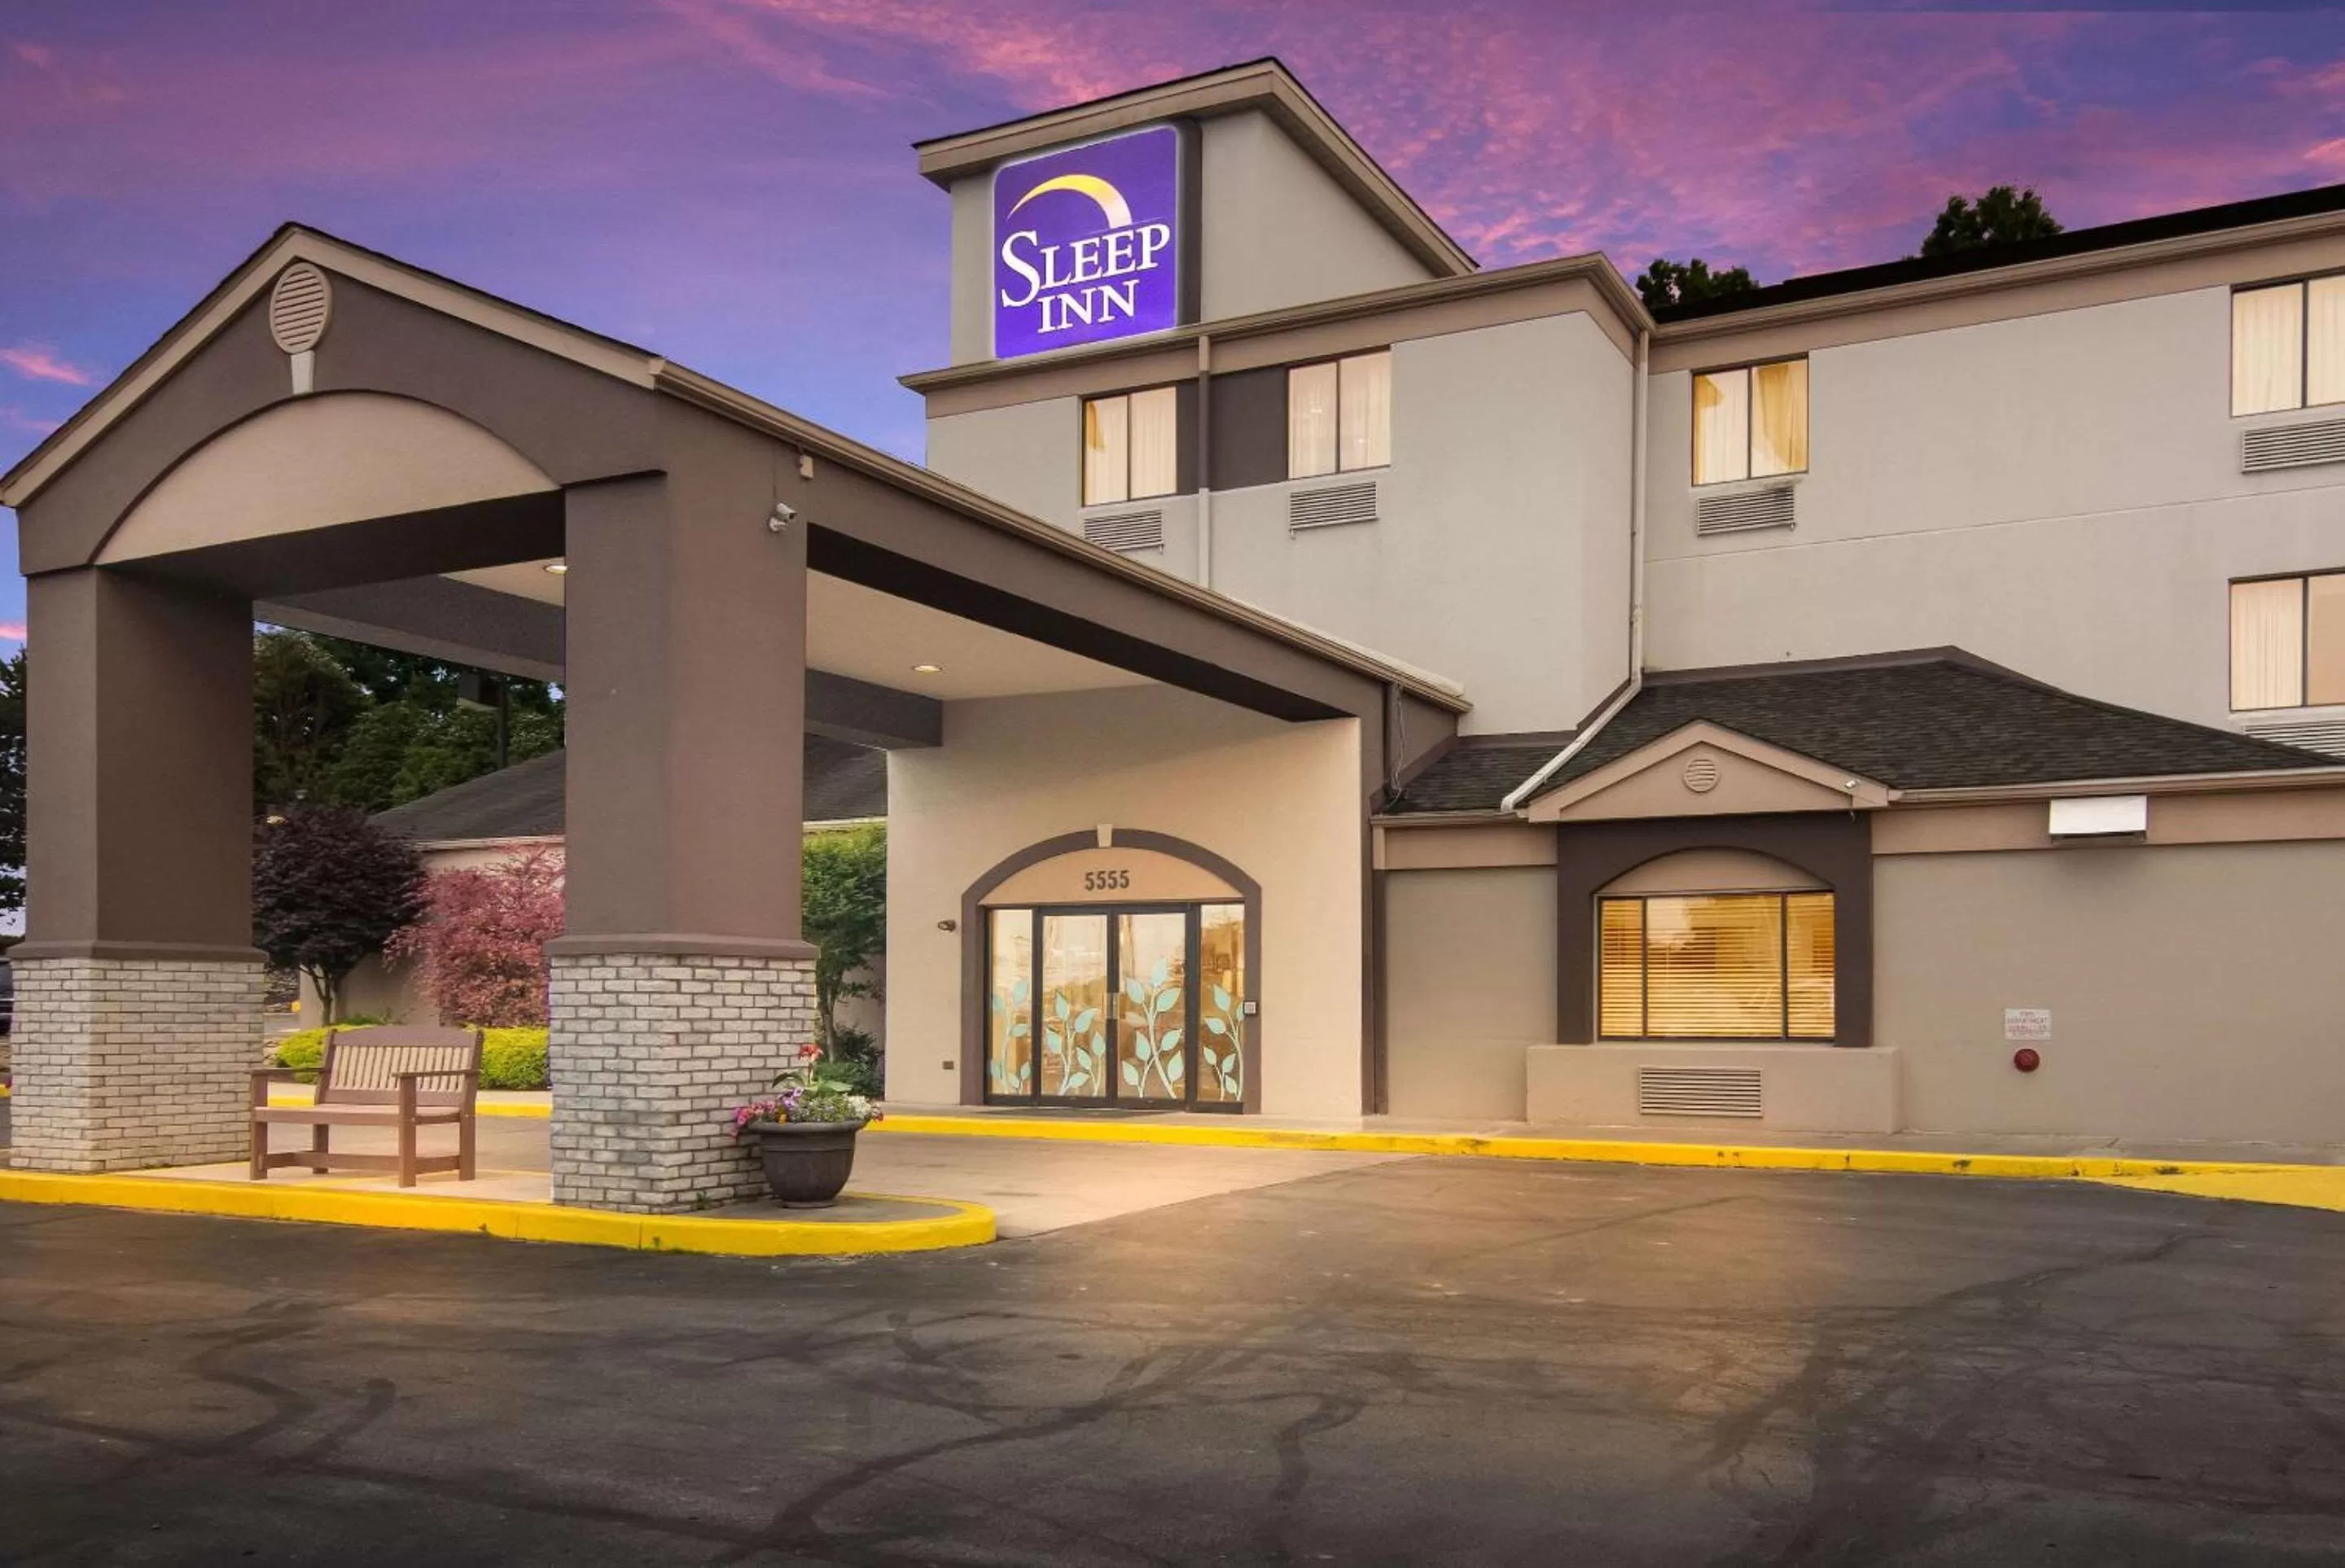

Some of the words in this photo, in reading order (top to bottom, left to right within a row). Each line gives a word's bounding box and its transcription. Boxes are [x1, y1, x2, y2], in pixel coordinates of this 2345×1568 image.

[1002, 223, 1170, 307] SLEEP
[1038, 279, 1139, 333] INN
[1085, 869, 1129, 891] 5555
